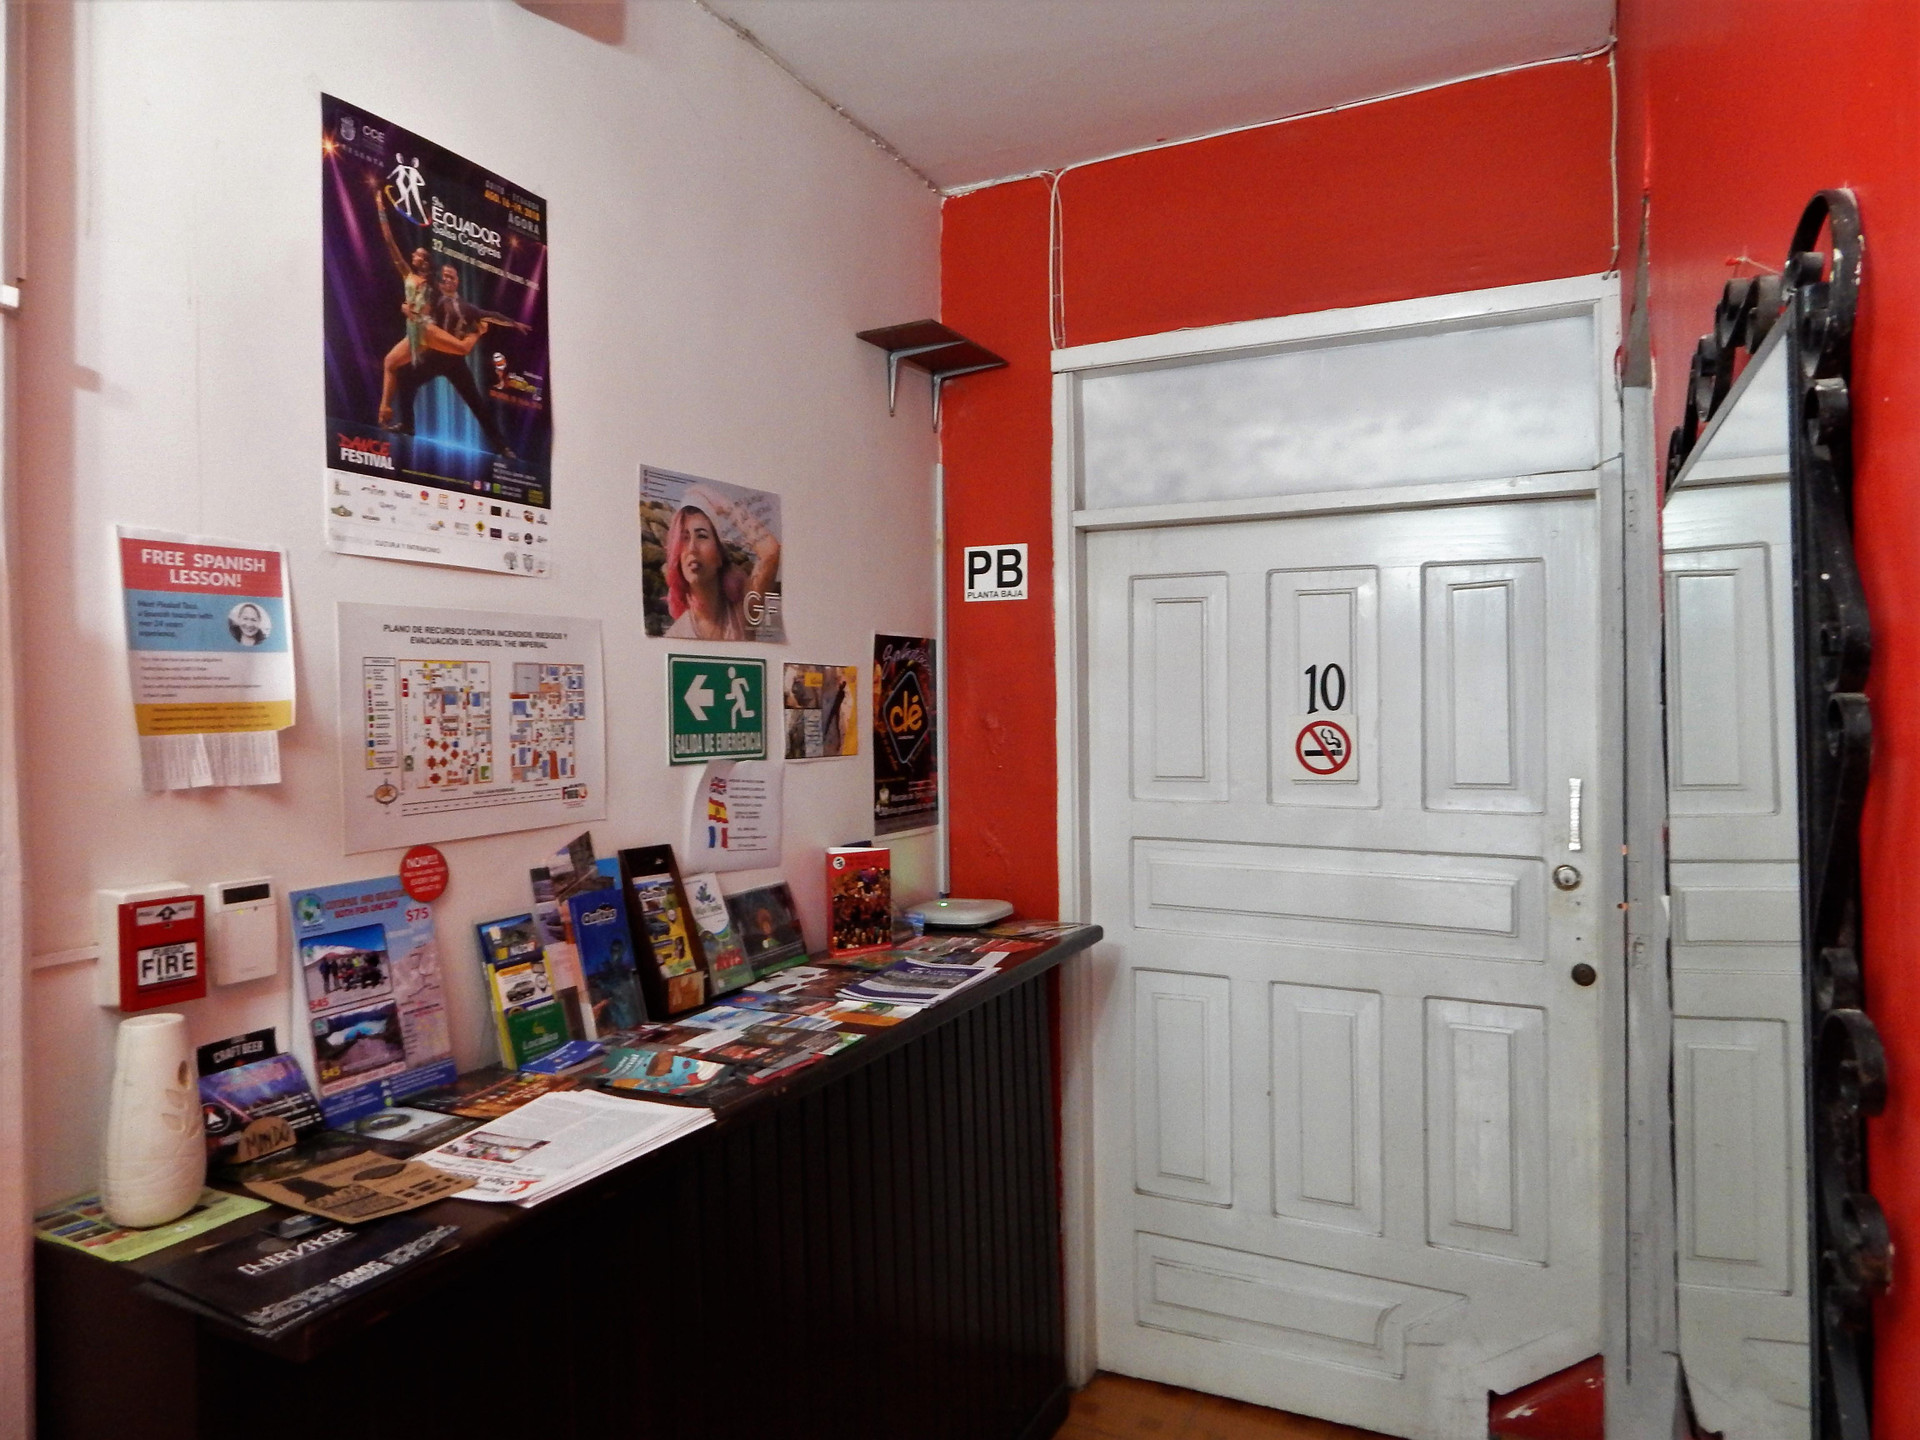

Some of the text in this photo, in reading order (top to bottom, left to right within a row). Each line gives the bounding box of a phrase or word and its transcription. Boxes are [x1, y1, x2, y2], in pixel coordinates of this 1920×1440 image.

[362, 125, 385, 143] CCE
[432, 205, 501, 248] ECUADOR
[432, 221, 457, 241] Salsa
[458, 232, 502, 259] Congress
[337, 432, 392, 457] DANCE
[340, 447, 395, 470] FESTIVAL
[141, 548, 266, 573] FREE SPANISH
[968, 548, 1023, 590] PB
[169, 568, 242, 588] LESSON!
[967, 589, 1023, 599] PLANTA BAJA
[743, 590, 781, 626] GF
[383, 624, 410, 633] PLANO
[412, 625, 423, 634] DE
[424, 626, 465, 636] RECURSOS
[467, 628, 496, 637] CONTRA
[535, 631, 562, 640] RIESGOS
[409, 636, 548, 649] EVACUACIÓN DEL HOSTAL THE IMPERIAL
[1304, 663, 1346, 715] 10
[675, 731, 761, 754] SALIDA DE EMERGENCIA
[406, 907, 430, 923] $75
[142, 952, 195, 978] FIRE
[309, 997, 329, 1010] $45
[213, 1044, 241, 1064] CRAFT
[241, 1040, 264, 1054] BEER
[321, 1065, 341, 1080] $45
